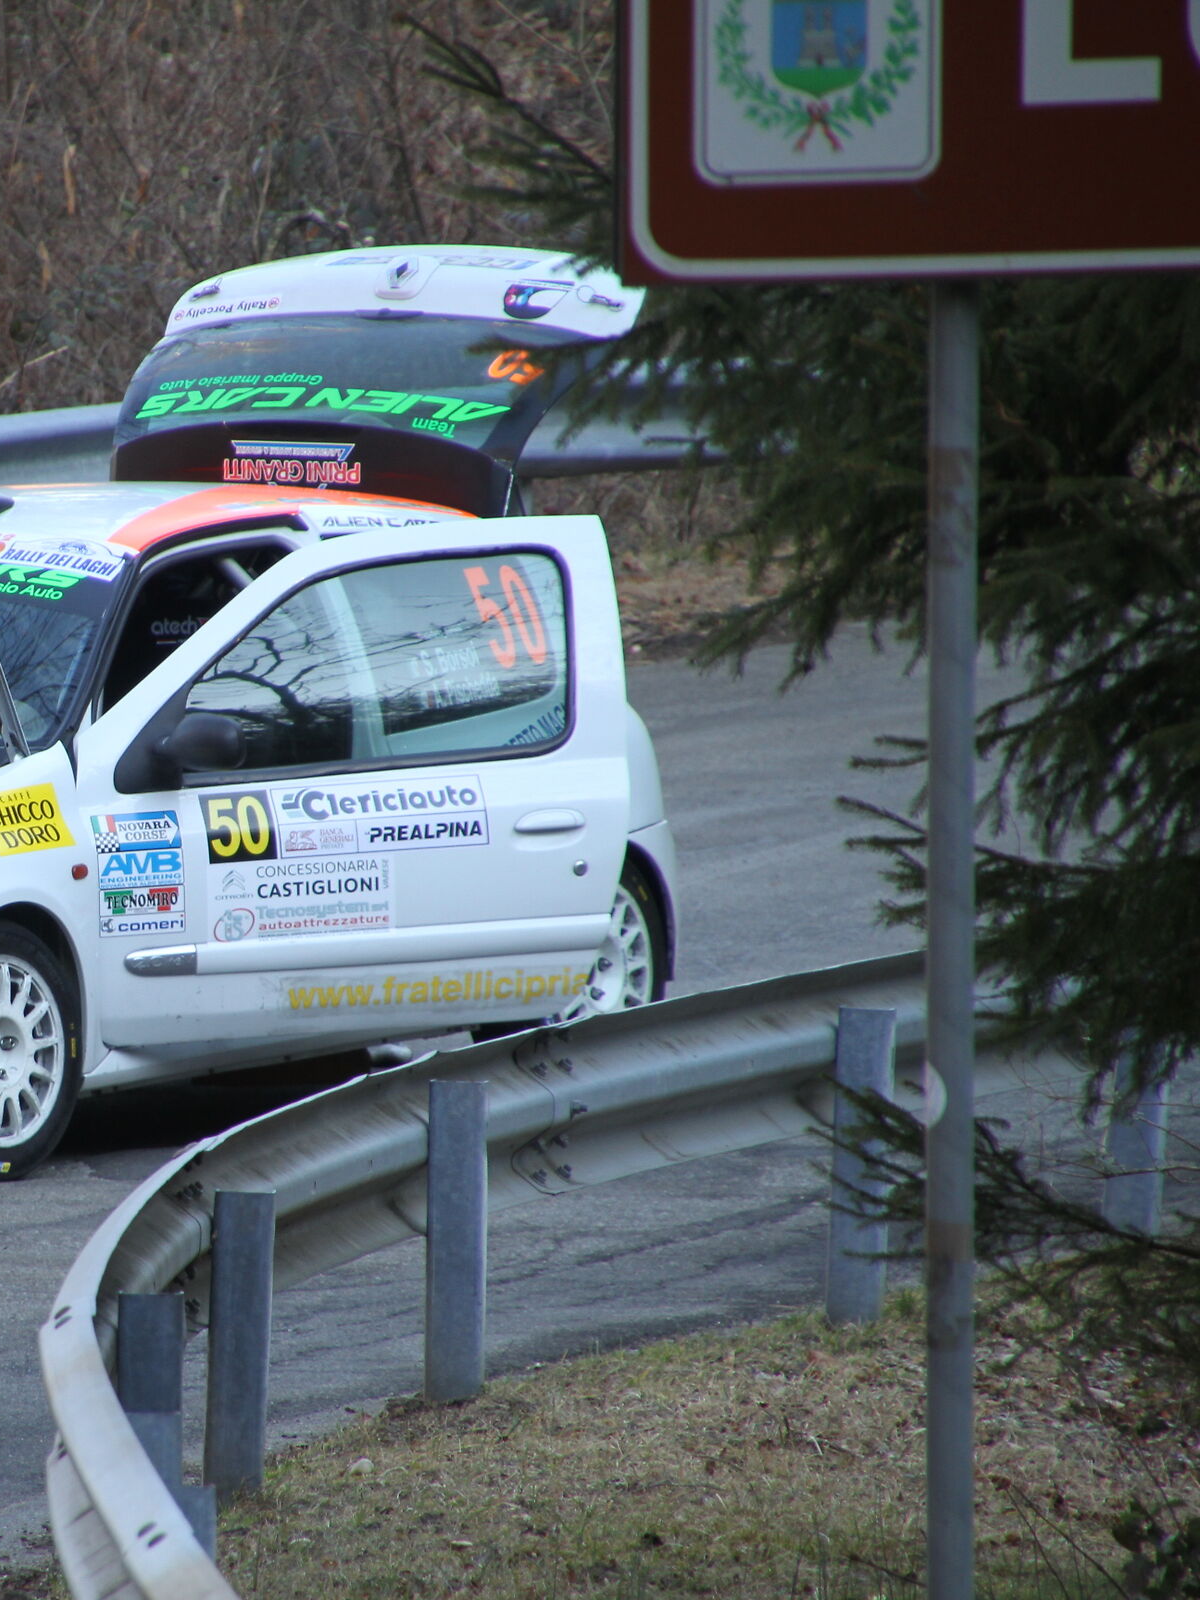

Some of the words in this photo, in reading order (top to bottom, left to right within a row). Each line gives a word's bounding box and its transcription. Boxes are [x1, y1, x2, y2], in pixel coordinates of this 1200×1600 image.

[186, 304, 233, 318] Porcelly
[237, 300, 267, 311] Rally
[160, 378, 197, 391] Auto
[198, 374, 262, 387] Imarisio
[264, 373, 323, 387] Gruppo
[136, 387, 305, 419] CARS
[305, 387, 511, 422] ALIEN
[412, 416, 455, 439] Team
[224, 458, 304, 483] GRANITI
[306, 461, 361, 484] PRINI
[322, 516, 384, 528] ALIEN
[386, 517, 440, 528] CA
[1, 548, 47, 564] RALLY
[45, 553, 72, 567] DEI
[71, 559, 117, 576] LAGHI
[20, 586, 64, 601] Auto
[463, 565, 546, 668] 50
[301, 785, 477, 821] Clericiauto
[118, 819, 172, 832] NOVARA
[208, 795, 270, 857] 50
[369, 820, 483, 843] PREALPINA
[125, 829, 168, 842] CORSE
[101, 850, 183, 877] AMB
[256, 859, 378, 879] CONCESSIONARIA
[100, 873, 181, 884] ENGINEERING
[257, 876, 379, 899] CASTIGLIONI
[106, 891, 179, 910] TECNOMIRO
[118, 914, 184, 932] comeri
[258, 914, 390, 931] autoattrezzature
